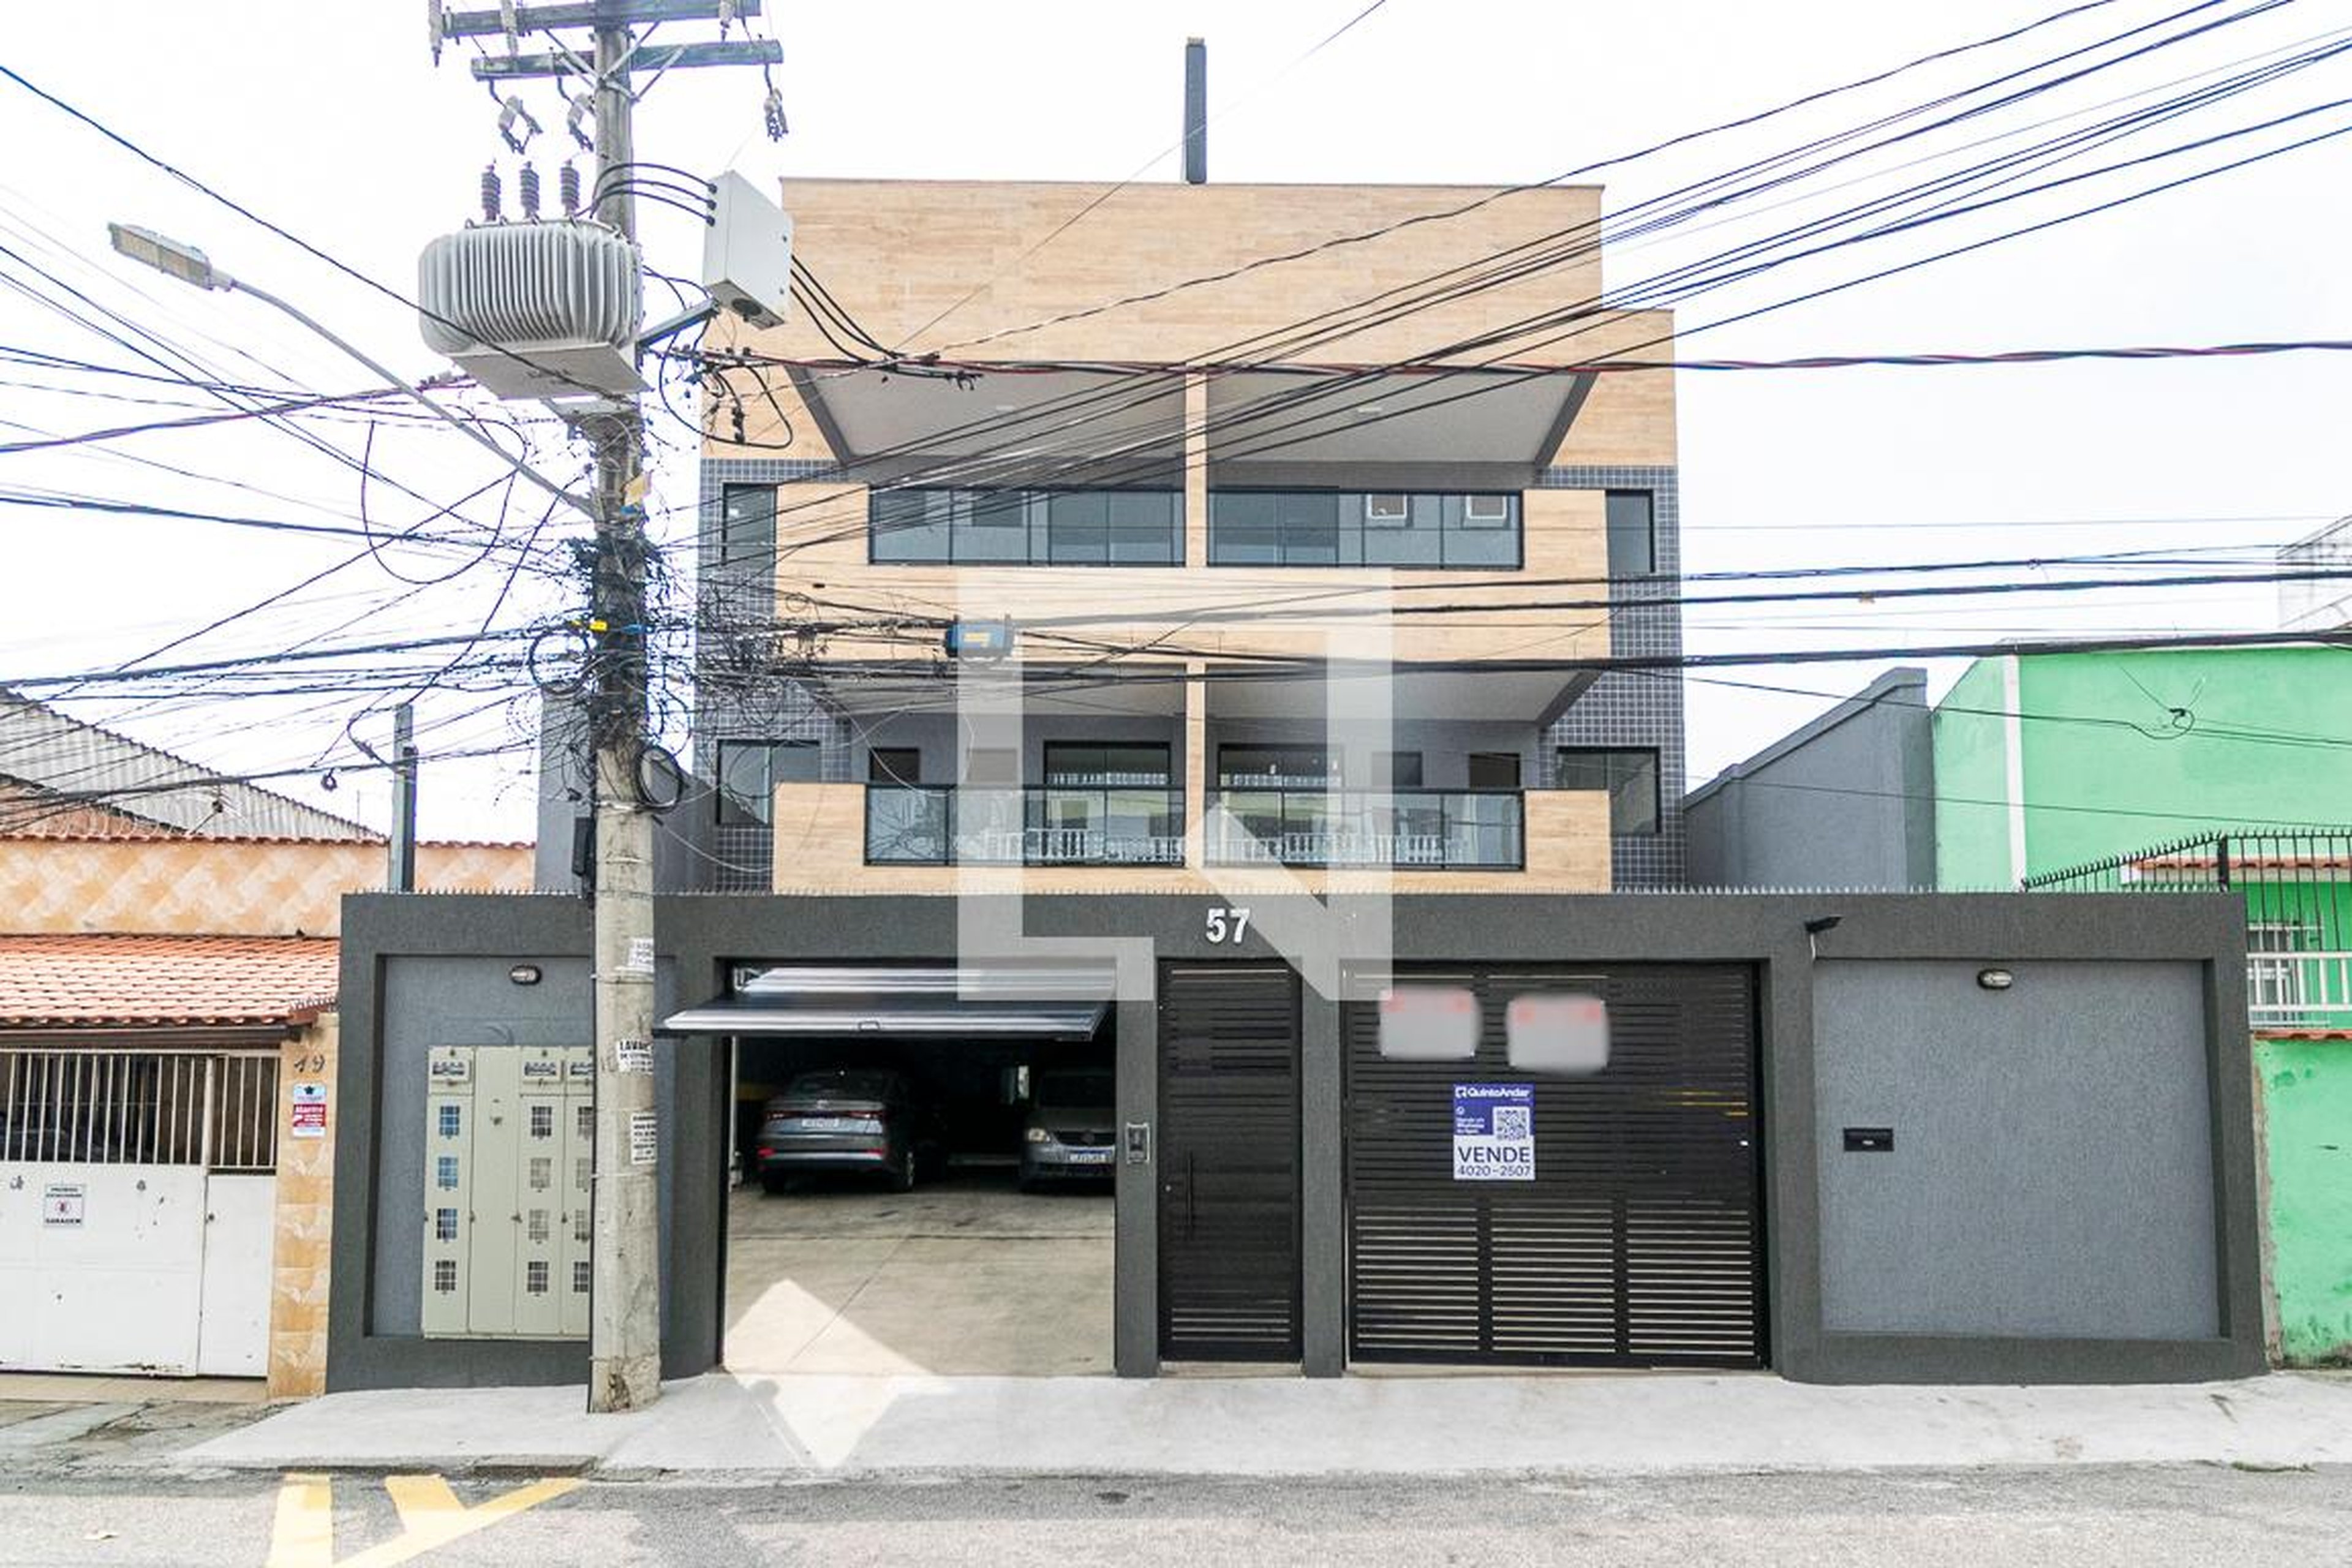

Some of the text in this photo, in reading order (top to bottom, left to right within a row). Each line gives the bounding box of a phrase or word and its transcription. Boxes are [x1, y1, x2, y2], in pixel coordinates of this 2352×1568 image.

[1206, 908, 1250, 943] 57
[1468, 1087, 1530, 1098] QuintoAndar
[1458, 1146, 1531, 1163] VENDE
[1457, 1165, 1531, 1177] 4020-2507
